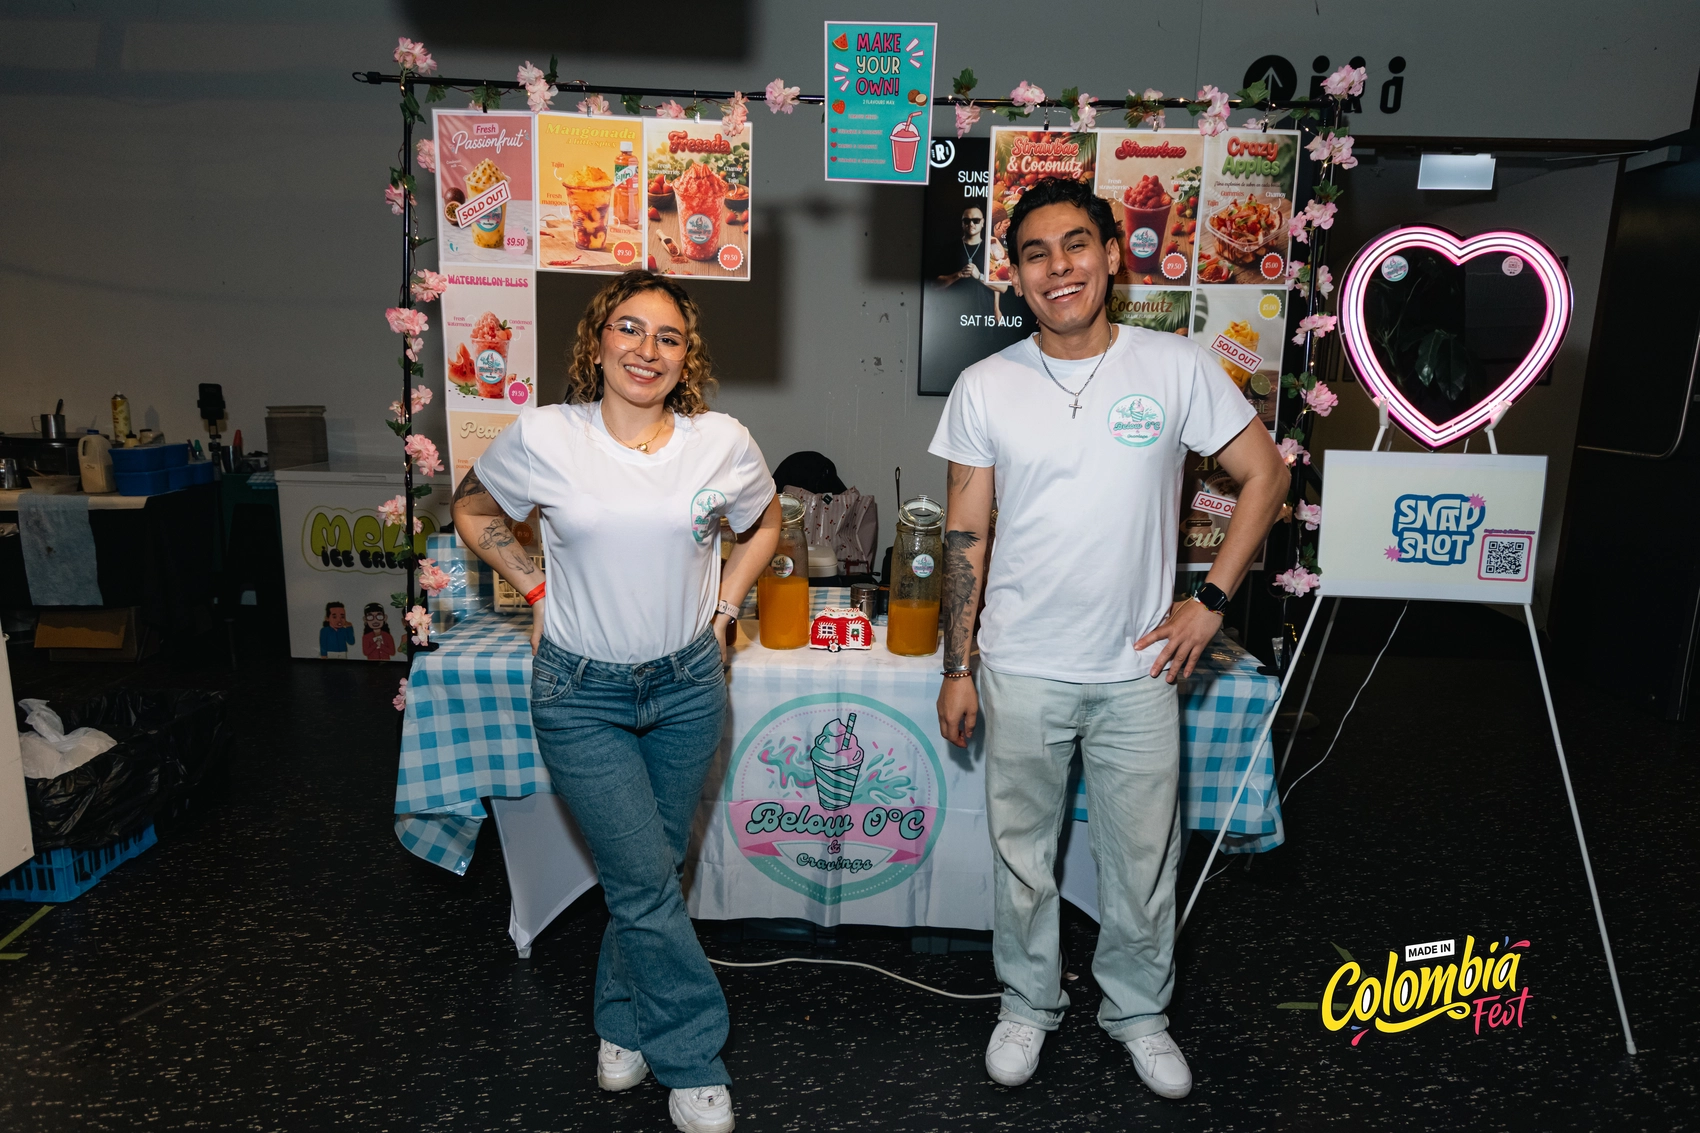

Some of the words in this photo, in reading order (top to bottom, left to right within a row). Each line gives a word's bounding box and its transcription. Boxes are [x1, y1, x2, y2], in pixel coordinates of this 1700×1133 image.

[857, 32, 901, 52] MAKE
[856, 55, 901, 74] YOUR
[855, 77, 900, 96] OWN!
[476, 125, 496, 134] Fresh
[546, 123, 636, 139] Mangonada
[451, 128, 524, 154] Passionfruit
[668, 130, 731, 155] Fresada
[1011, 137, 1079, 157] Strawbae
[1115, 139, 1187, 160] Strawbae
[1227, 136, 1279, 161] Crazy
[1006, 156, 1018, 172] &
[1021, 156, 1083, 179] Coconutz
[1222, 155, 1280, 179] Apples
[462, 202, 485, 220] SOLD
[486, 189, 504, 205] OUT
[507, 238, 525, 247] $9.50
[1108, 297, 1173, 313] Coconutz
[960, 315, 981, 327] SAT
[984, 315, 996, 327] 15
[998, 316, 1022, 328] AUG
[1217, 340, 1238, 357] SOLD
[1238, 353, 1257, 367] OUT
[1113, 421, 1142, 431] Below
[1199, 498, 1223, 510] SOLD
[1398, 499, 1480, 532] SNAP
[1401, 532, 1470, 561] SHOT
[745, 801, 854, 838] Below
[827, 839, 841, 855] &
[796, 853, 873, 873] Cravings
